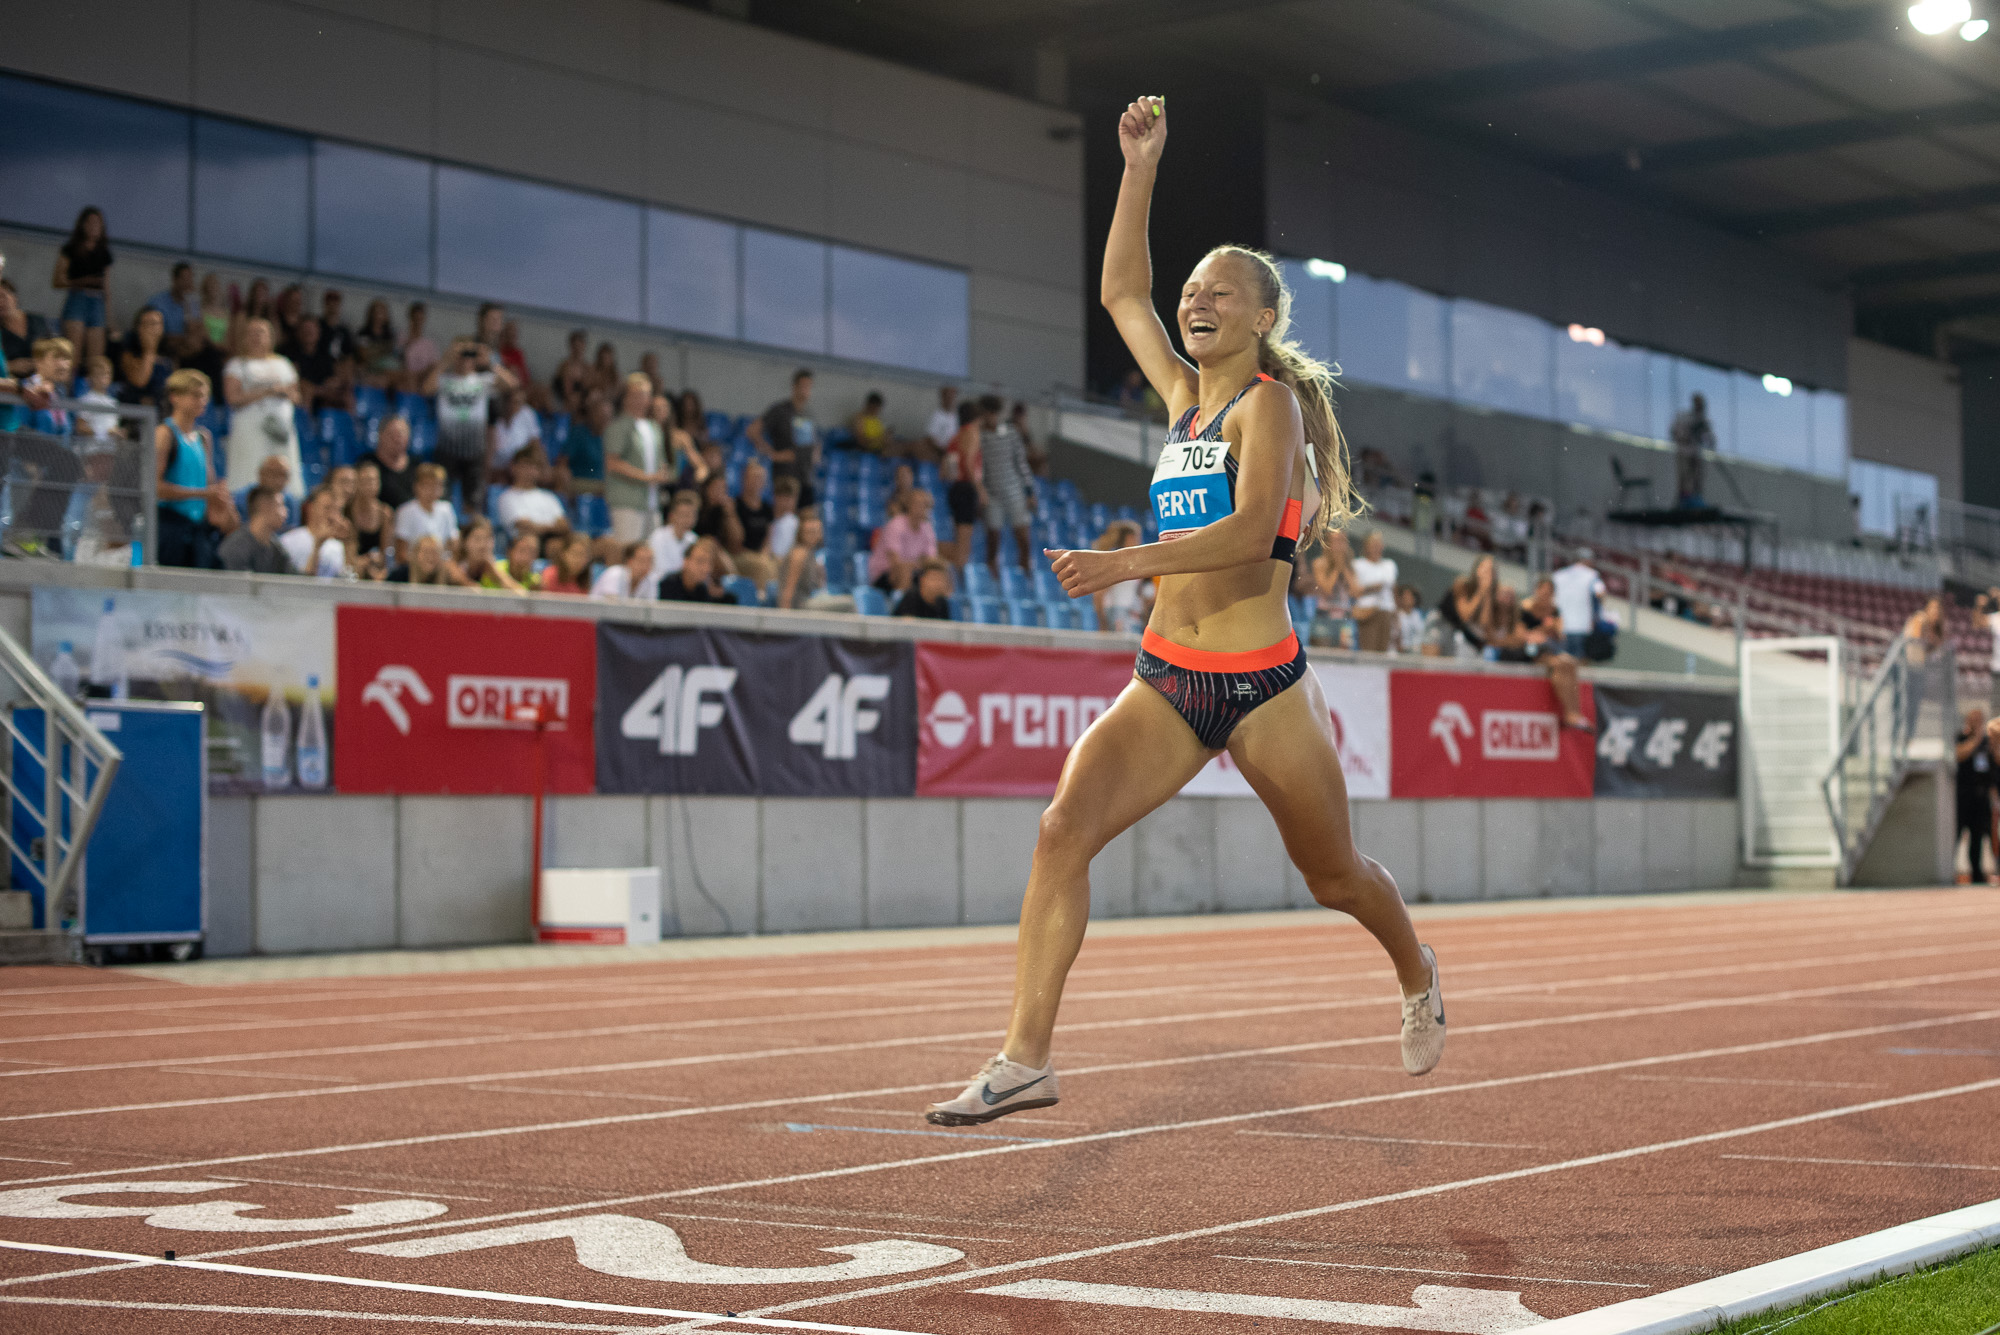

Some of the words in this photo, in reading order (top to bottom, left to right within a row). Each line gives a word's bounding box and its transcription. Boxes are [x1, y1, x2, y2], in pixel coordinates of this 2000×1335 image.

[1181, 445, 1220, 472] 705
[1156, 487, 1208, 520] PERYT
[620, 664, 738, 756] 4F
[788, 672, 891, 760] 4F
[977, 692, 1116, 748] ren
[1597, 717, 1639, 766] 4F
[1644, 718, 1689, 768] 4F
[1690, 720, 1733, 769] 4F
[0, 1180, 449, 1232] 3
[346, 1213, 965, 1285] 2
[965, 1277, 1550, 1335] 1
